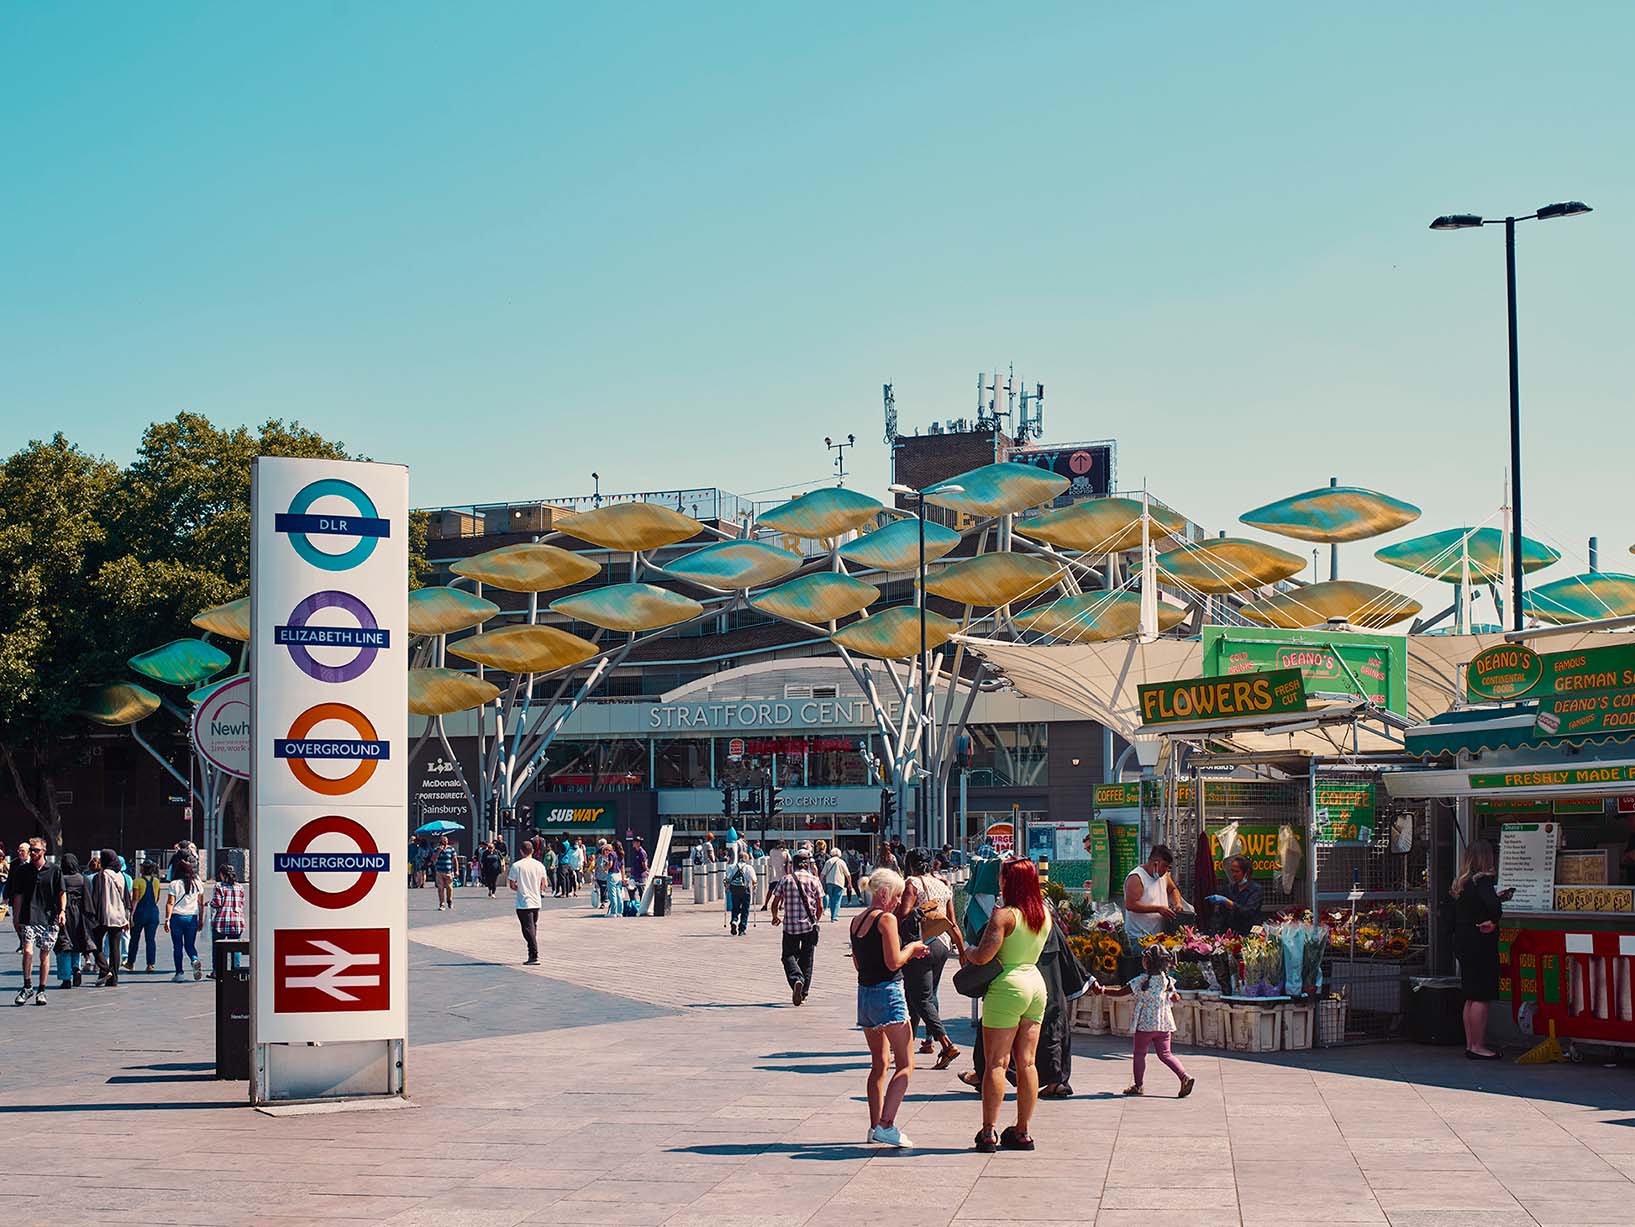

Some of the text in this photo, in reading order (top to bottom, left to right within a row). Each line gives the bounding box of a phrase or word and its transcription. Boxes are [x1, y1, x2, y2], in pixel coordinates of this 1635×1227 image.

[319, 519, 348, 531] DLR
[280, 630, 384, 644] ELIZABETH LINE
[1281, 651, 1334, 670] DEANO'S
[1477, 651, 1531, 675] DEANO'S
[1553, 655, 1587, 673] FAMOUS
[1274, 679, 1300, 697] FRESH
[1553, 671, 1617, 692] GERMAN
[1143, 679, 1273, 719] FLOWERS
[1282, 694, 1298, 706] CUT
[1554, 695, 1609, 714] DEANO'S
[650, 700, 900, 728] STRATFORD CENTE
[285, 743, 380, 755] OVERGROUND
[1505, 771, 1569, 785] FRESHLY
[1576, 767, 1620, 781] MADE
[796, 796, 838, 806] CENTRE
[1097, 790, 1123, 801] COFFEE
[1319, 791, 1369, 808] COFFEE
[546, 808, 605, 822] SUBWAY
[280, 857, 385, 869] UNDERGROUND
